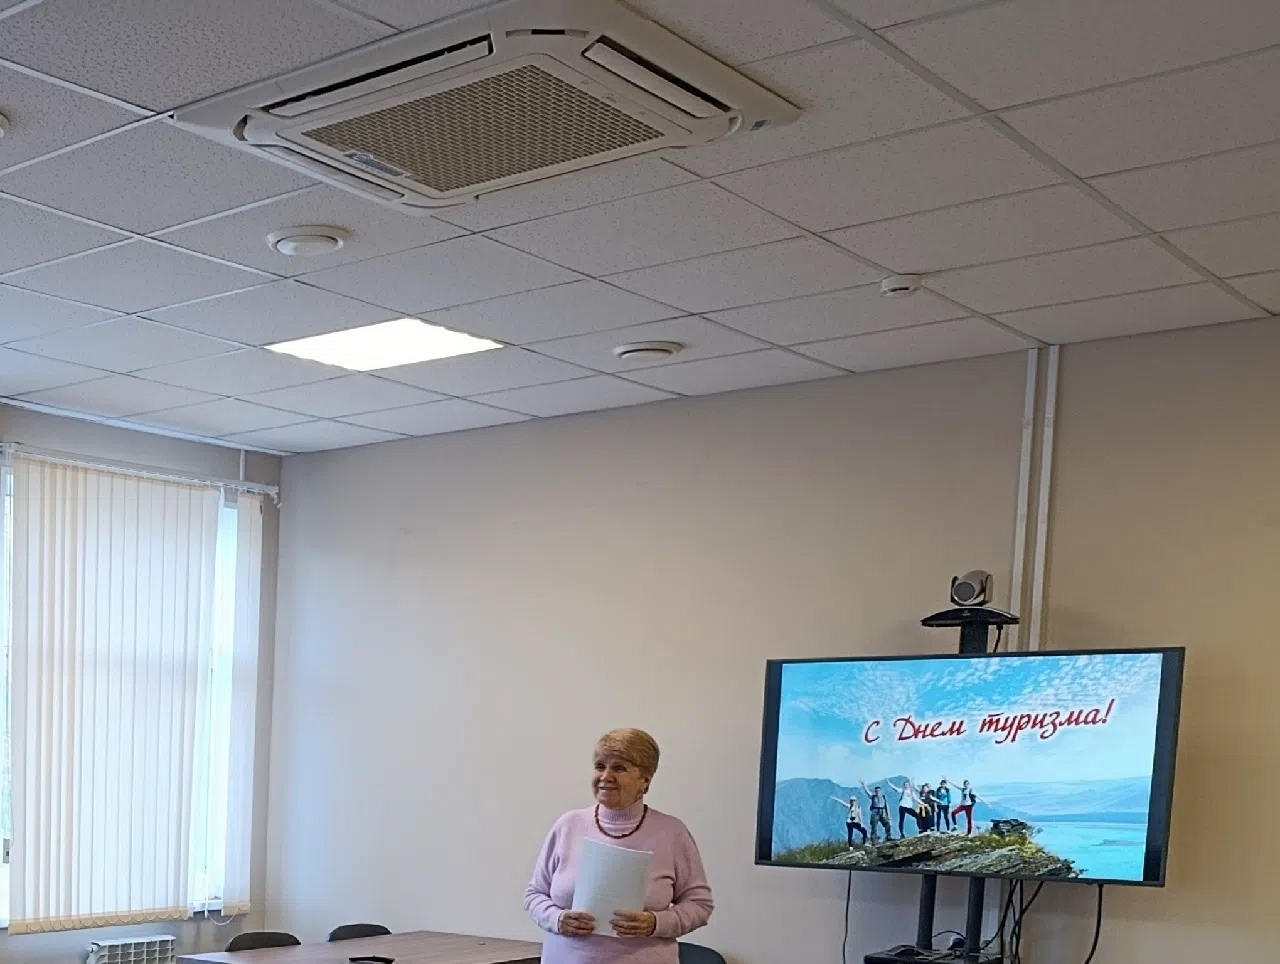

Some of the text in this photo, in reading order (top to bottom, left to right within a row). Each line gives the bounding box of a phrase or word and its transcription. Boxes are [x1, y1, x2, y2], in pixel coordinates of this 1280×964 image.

[864, 698, 1115, 744] С Днем туризма!
